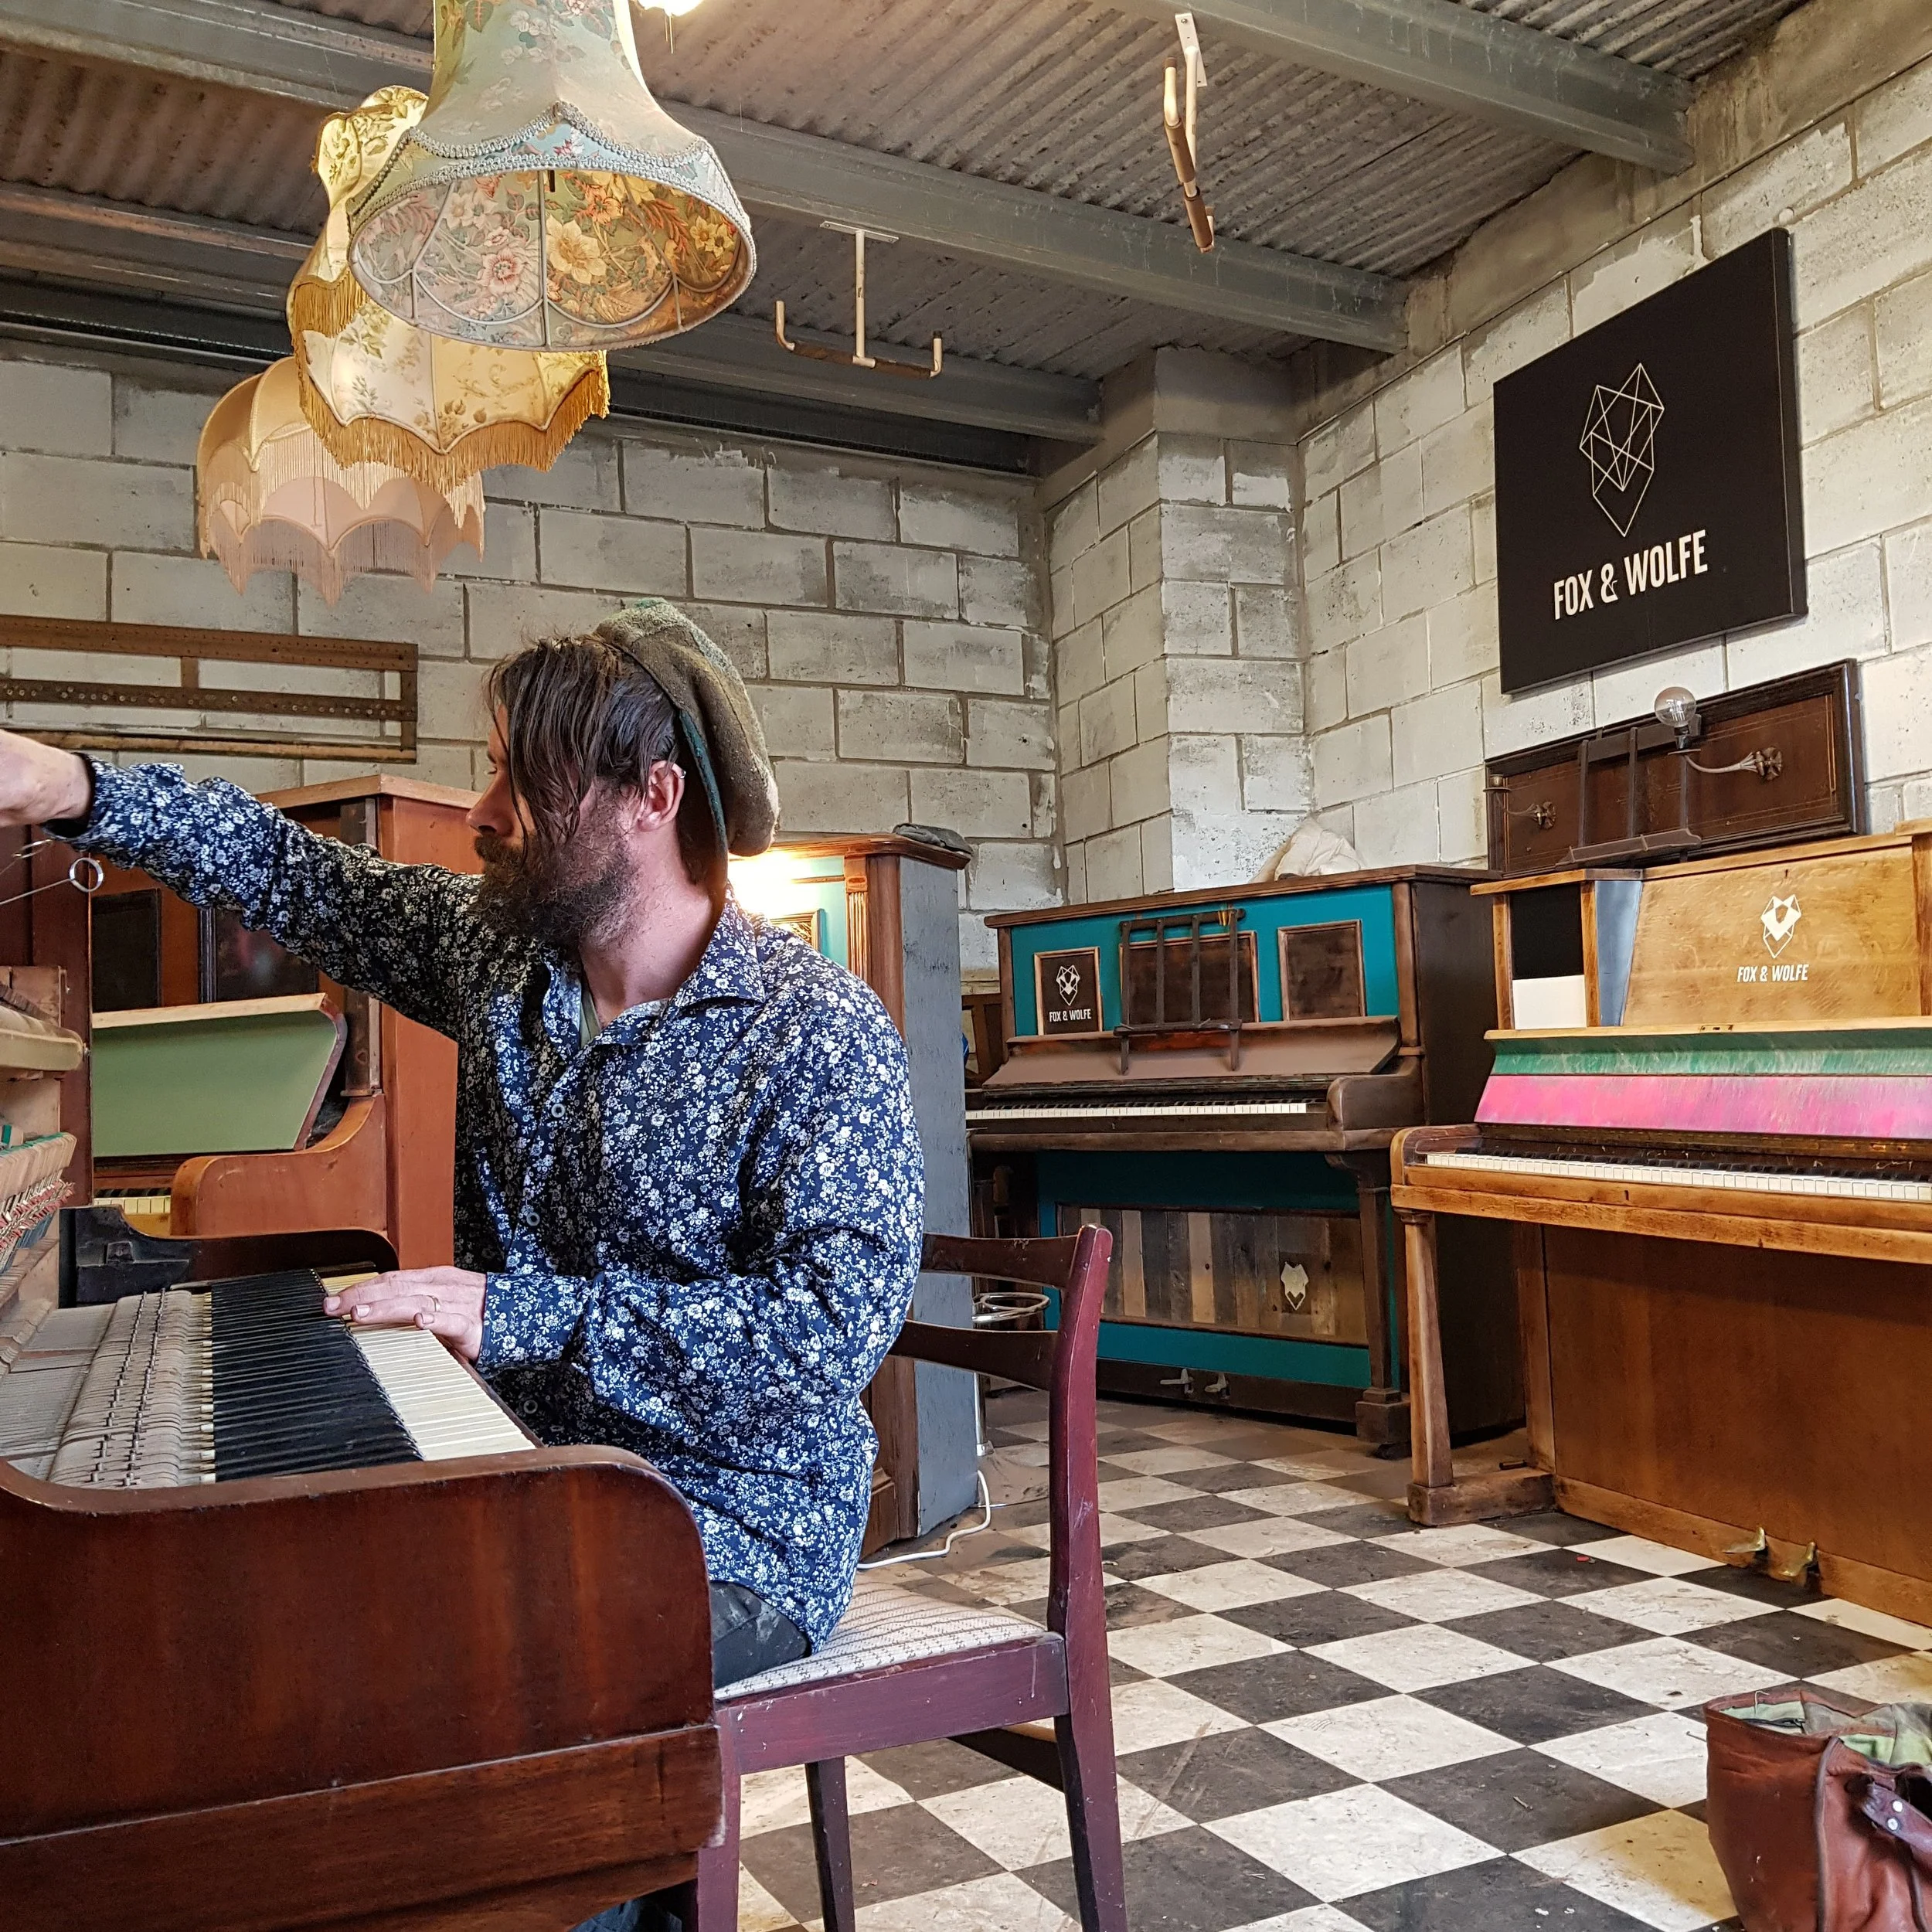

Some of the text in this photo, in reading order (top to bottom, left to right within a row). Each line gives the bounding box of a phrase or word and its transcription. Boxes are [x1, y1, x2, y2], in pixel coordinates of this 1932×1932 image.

[1554, 529, 1708, 620] FOX & WOLFE
[1736, 964, 1809, 982] FOX & WOLFE
[1049, 1009, 1092, 1022] FOX & WOLFE
